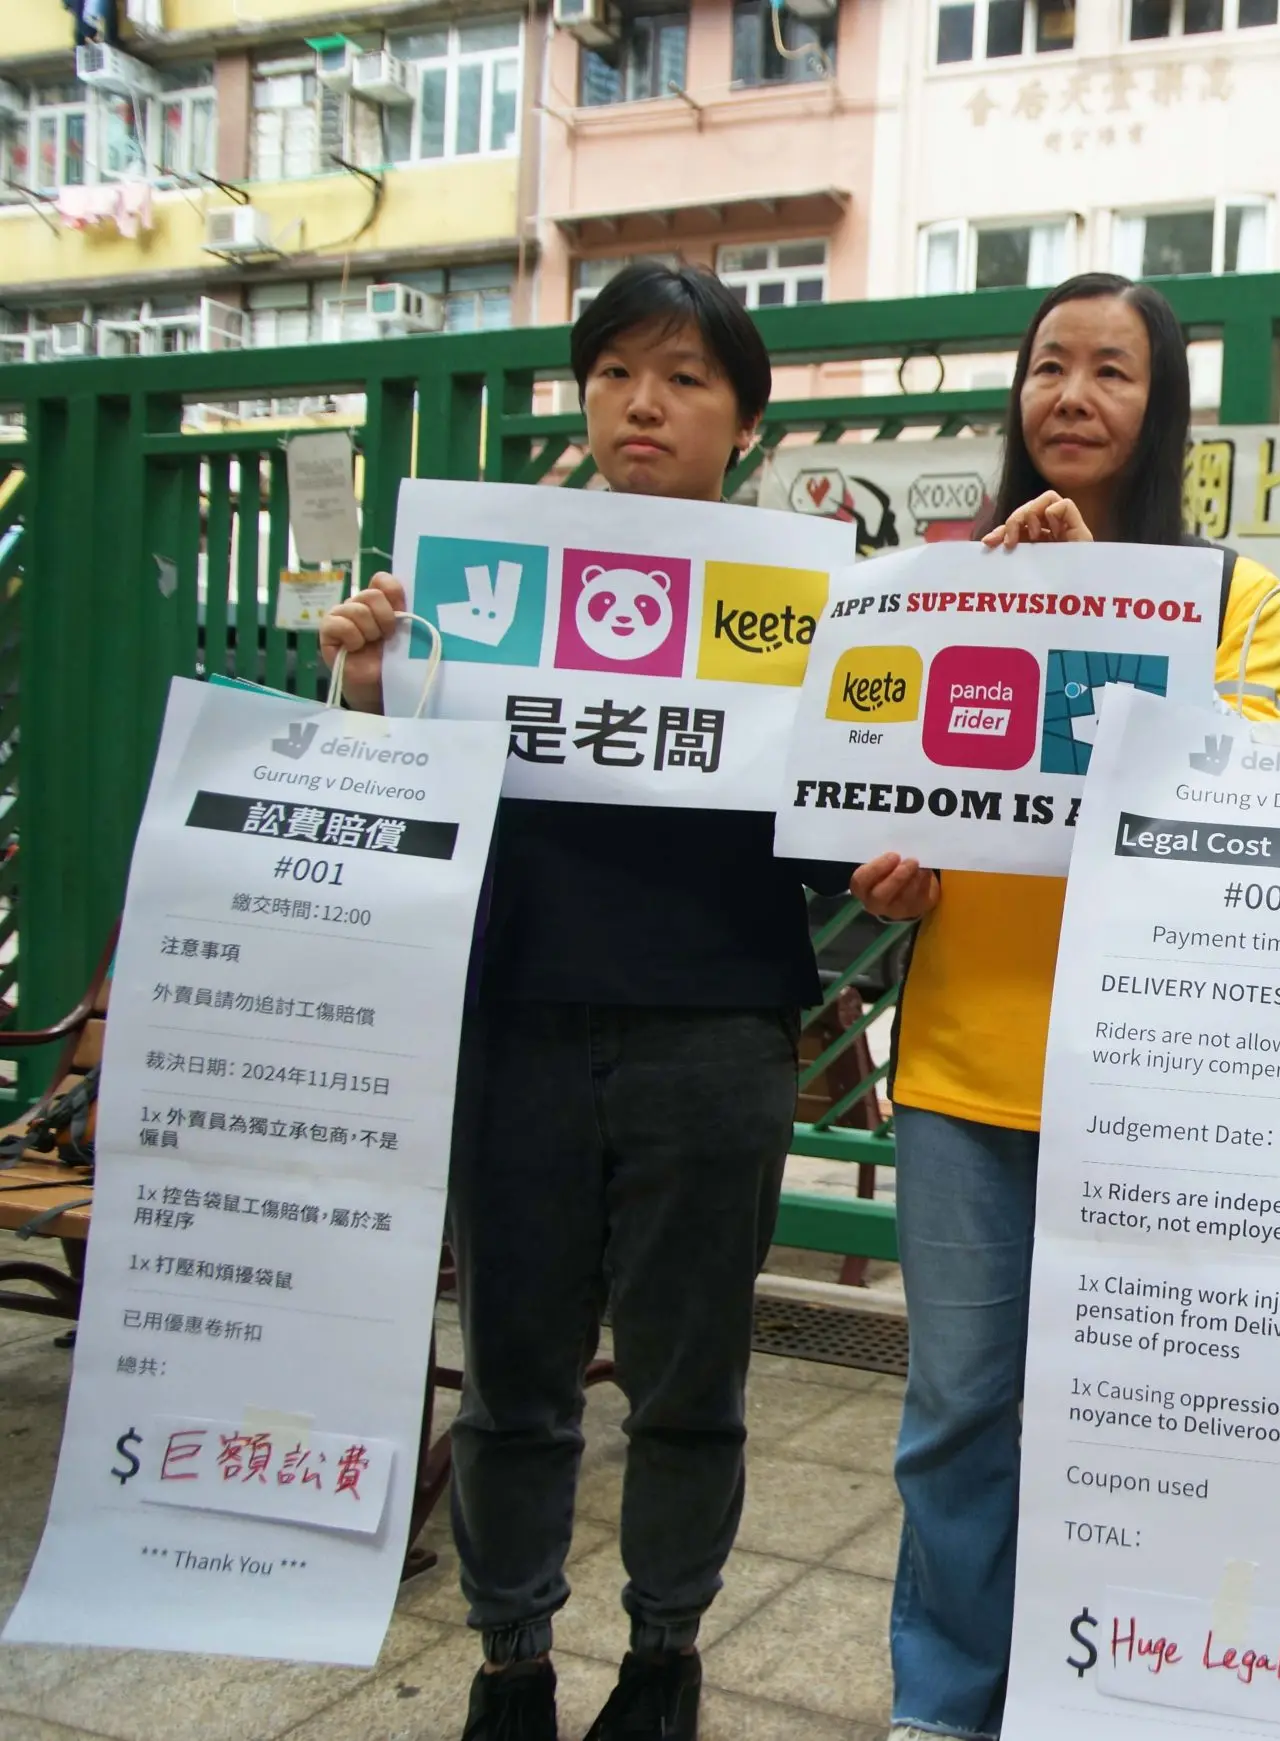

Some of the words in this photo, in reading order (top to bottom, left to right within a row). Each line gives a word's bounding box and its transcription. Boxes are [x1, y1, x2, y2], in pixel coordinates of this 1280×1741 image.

[913, 484, 978, 508] XOXO
[830, 596, 874, 619] APP
[878, 593, 901, 613] IS
[906, 592, 1106, 617] SUPERVISION
[1113, 597, 1202, 623] TOOL
[715, 600, 816, 653] keeta
[842, 671, 906, 712] keeta
[949, 680, 1013, 704] panda
[505, 695, 726, 773] 是老闆
[953, 709, 1005, 731] rider
[320, 736, 429, 767] deliveroo
[848, 729, 884, 746] Rider
[253, 764, 321, 791] Gurung
[326, 776, 334, 790] v
[340, 776, 426, 801] Deliveroo
[1175, 784, 1251, 811] Gurung
[1256, 794, 1268, 808] v
[794, 779, 1001, 821] FREEDOM
[1013, 793, 1053, 826] IS
[242, 801, 406, 852] 訟費賠償
[1121, 824, 1199, 855] Legal
[1207, 832, 1271, 857] Cost
[273, 855, 345, 886] #001
[160, 935, 241, 963] 注意事項
[1153, 926, 1245, 950] Payment
[1101, 974, 1206, 999] DELIVERY
[152, 982, 376, 1027] 外賣員請勿追討工傷賠償
[1095, 1021, 1157, 1042] Riders
[1161, 1029, 1192, 1045] are
[1198, 1032, 1231, 1048] not
[1092, 1047, 1142, 1067] work
[1147, 1050, 1204, 1075] injury
[242, 1062, 390, 1097] 2024年11月15日
[140, 1105, 161, 1124] 1x
[1086, 1115, 1209, 1142] Judgement
[136, 1183, 157, 1202] 1x
[1082, 1180, 1103, 1200] 1x
[1108, 1182, 1170, 1205] Riders
[1176, 1192, 1209, 1208] are
[133, 1207, 195, 1230] 用程序
[1080, 1207, 1152, 1233] tractor,
[1157, 1216, 1191, 1233] not
[128, 1254, 150, 1272] 1x
[155, 1255, 294, 1290] 打壓和煩擾袋鼠
[1078, 1274, 1099, 1293] 1x
[1104, 1276, 1193, 1307] Claiming
[1198, 1287, 1249, 1308] work
[1076, 1301, 1175, 1327] pensation
[1180, 1309, 1228, 1332] from
[1074, 1326, 1133, 1348] abuse
[1138, 1332, 1161, 1350] of
[1163, 1339, 1240, 1360] process
[1070, 1377, 1092, 1396] 1x
[1097, 1380, 1175, 1409] Causing
[1069, 1405, 1152, 1428] noyance
[1158, 1414, 1178, 1431] to
[1184, 1415, 1280, 1442] Deliveroo
[110, 1427, 143, 1485] $
[160, 1430, 370, 1500] 巨額訟費
[1066, 1465, 1150, 1493] Coupon
[1157, 1479, 1209, 1500] used
[174, 1550, 233, 1573] Thank
[239, 1555, 273, 1577] You
[1066, 1606, 1099, 1678] $
[1111, 1617, 1183, 1674] Huge
